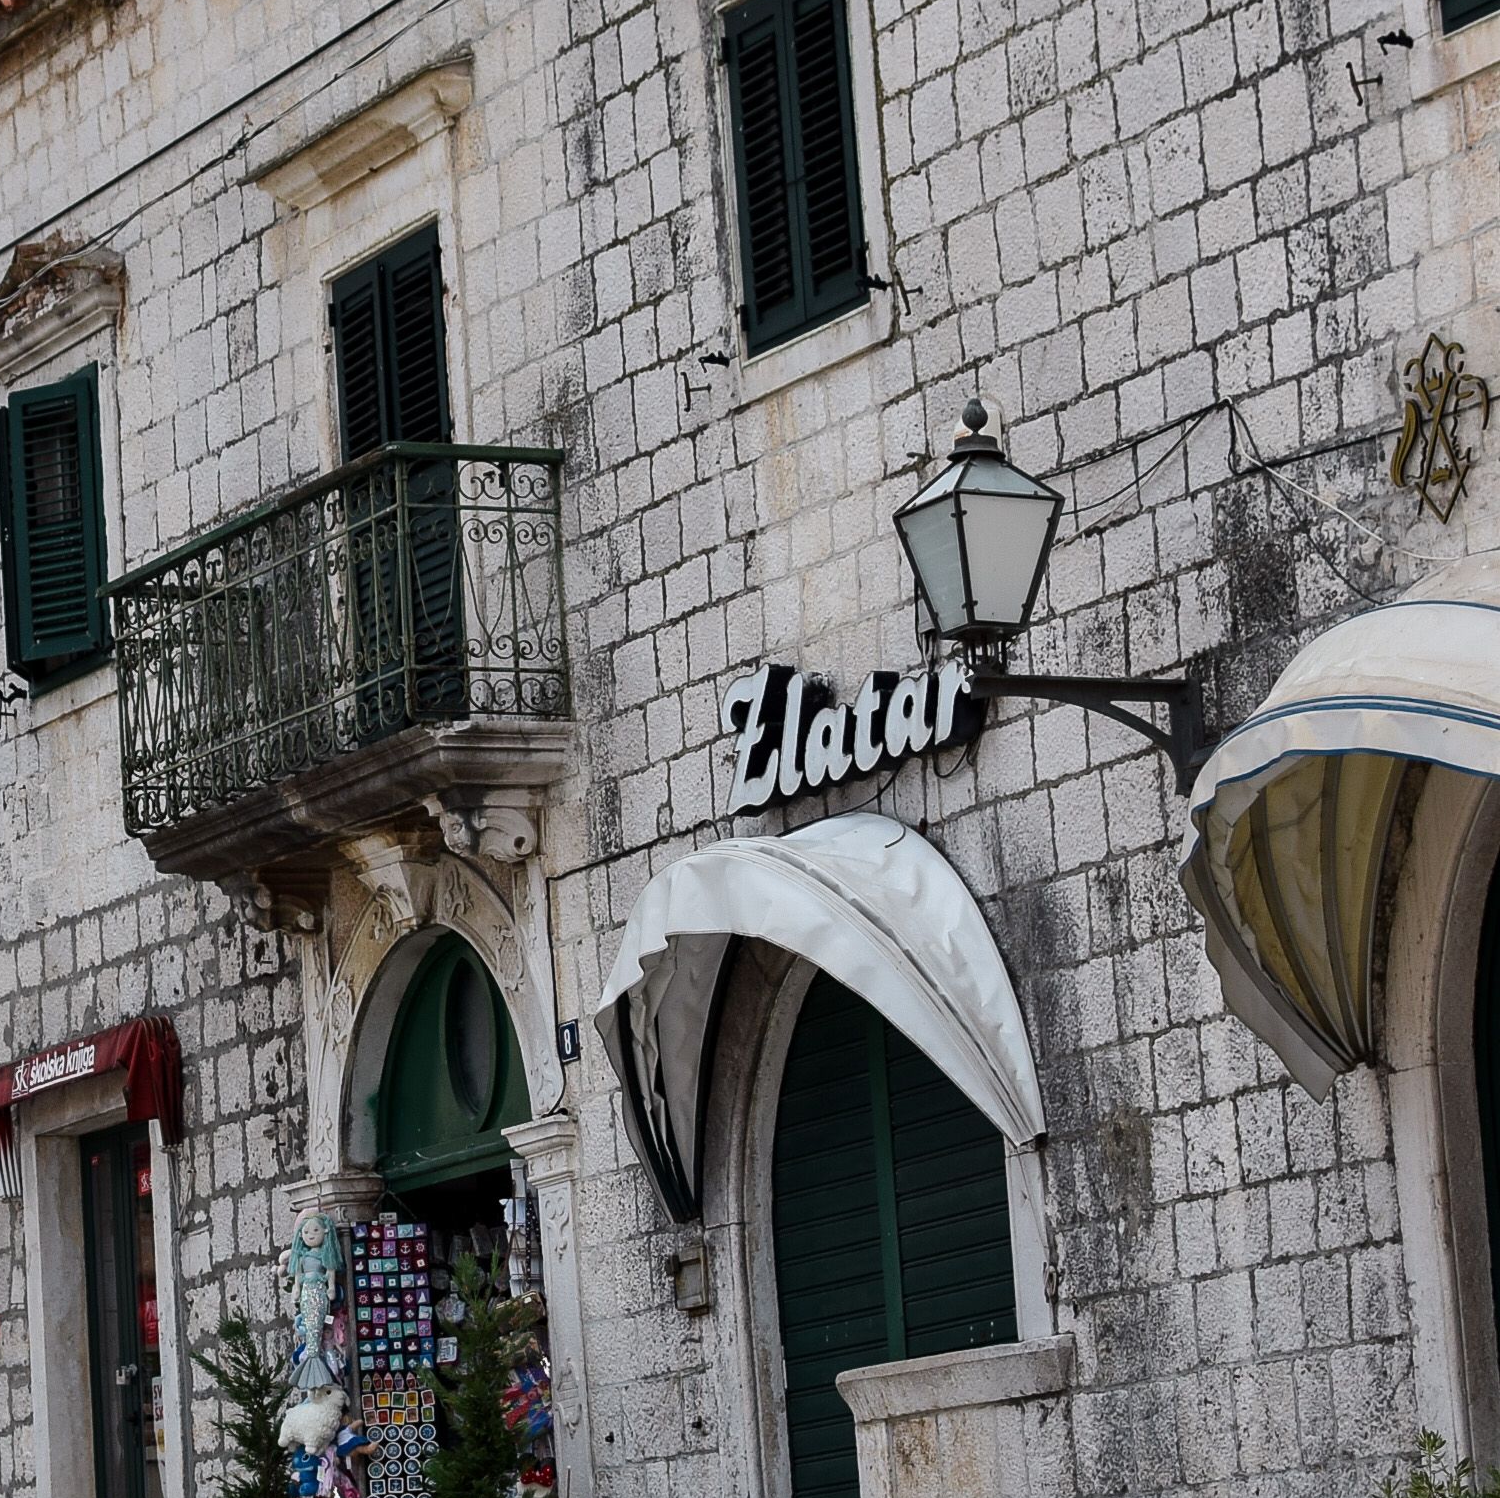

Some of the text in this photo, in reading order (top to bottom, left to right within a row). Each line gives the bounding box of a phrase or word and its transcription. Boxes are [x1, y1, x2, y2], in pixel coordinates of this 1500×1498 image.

[722, 662, 973, 816] Zlatar
[30, 1051, 65, 1086] školska
[66, 1041, 96, 1074] knjiga
[563, 1028, 572, 1055] 8
